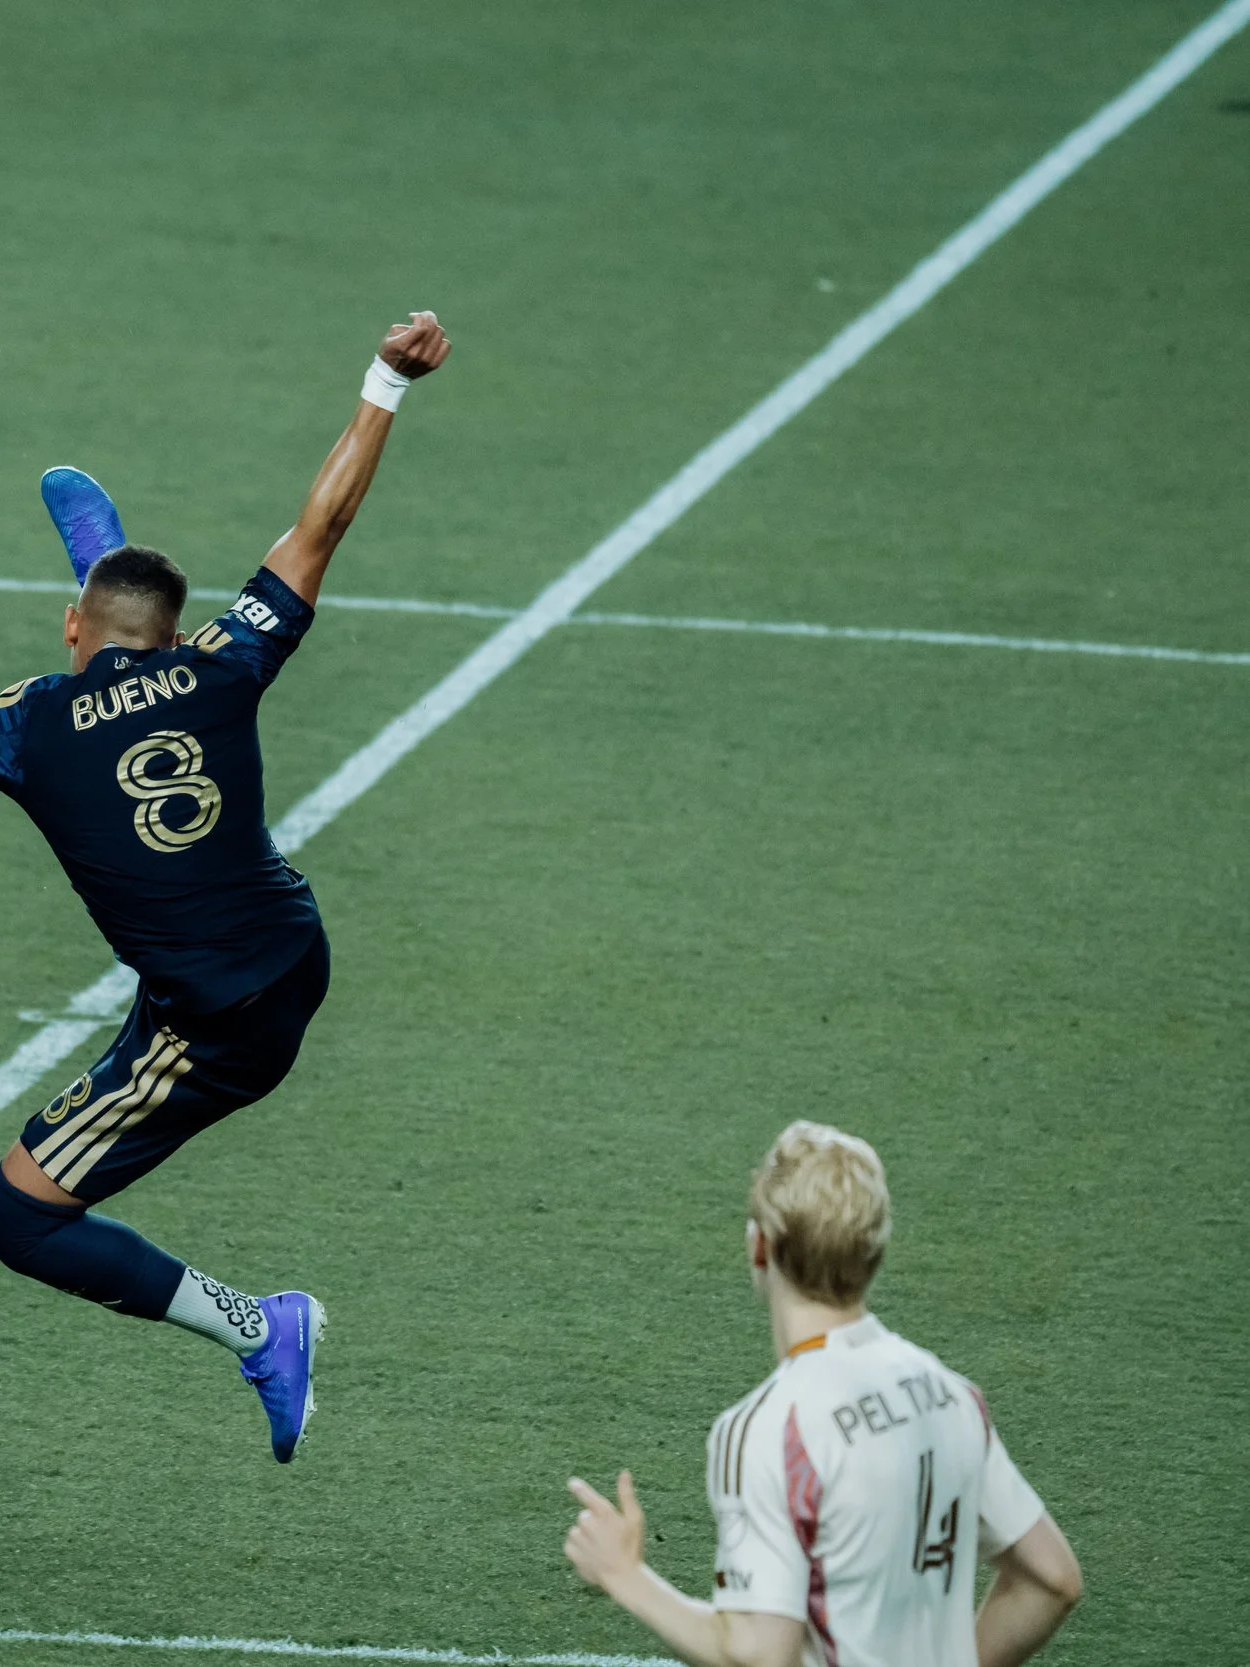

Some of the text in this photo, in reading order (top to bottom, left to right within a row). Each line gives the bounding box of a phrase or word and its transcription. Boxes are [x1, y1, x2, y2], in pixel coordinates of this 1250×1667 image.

[71, 664, 198, 732] BUENO
[116, 730, 222, 853] 8
[912, 1448, 960, 1596] 4
